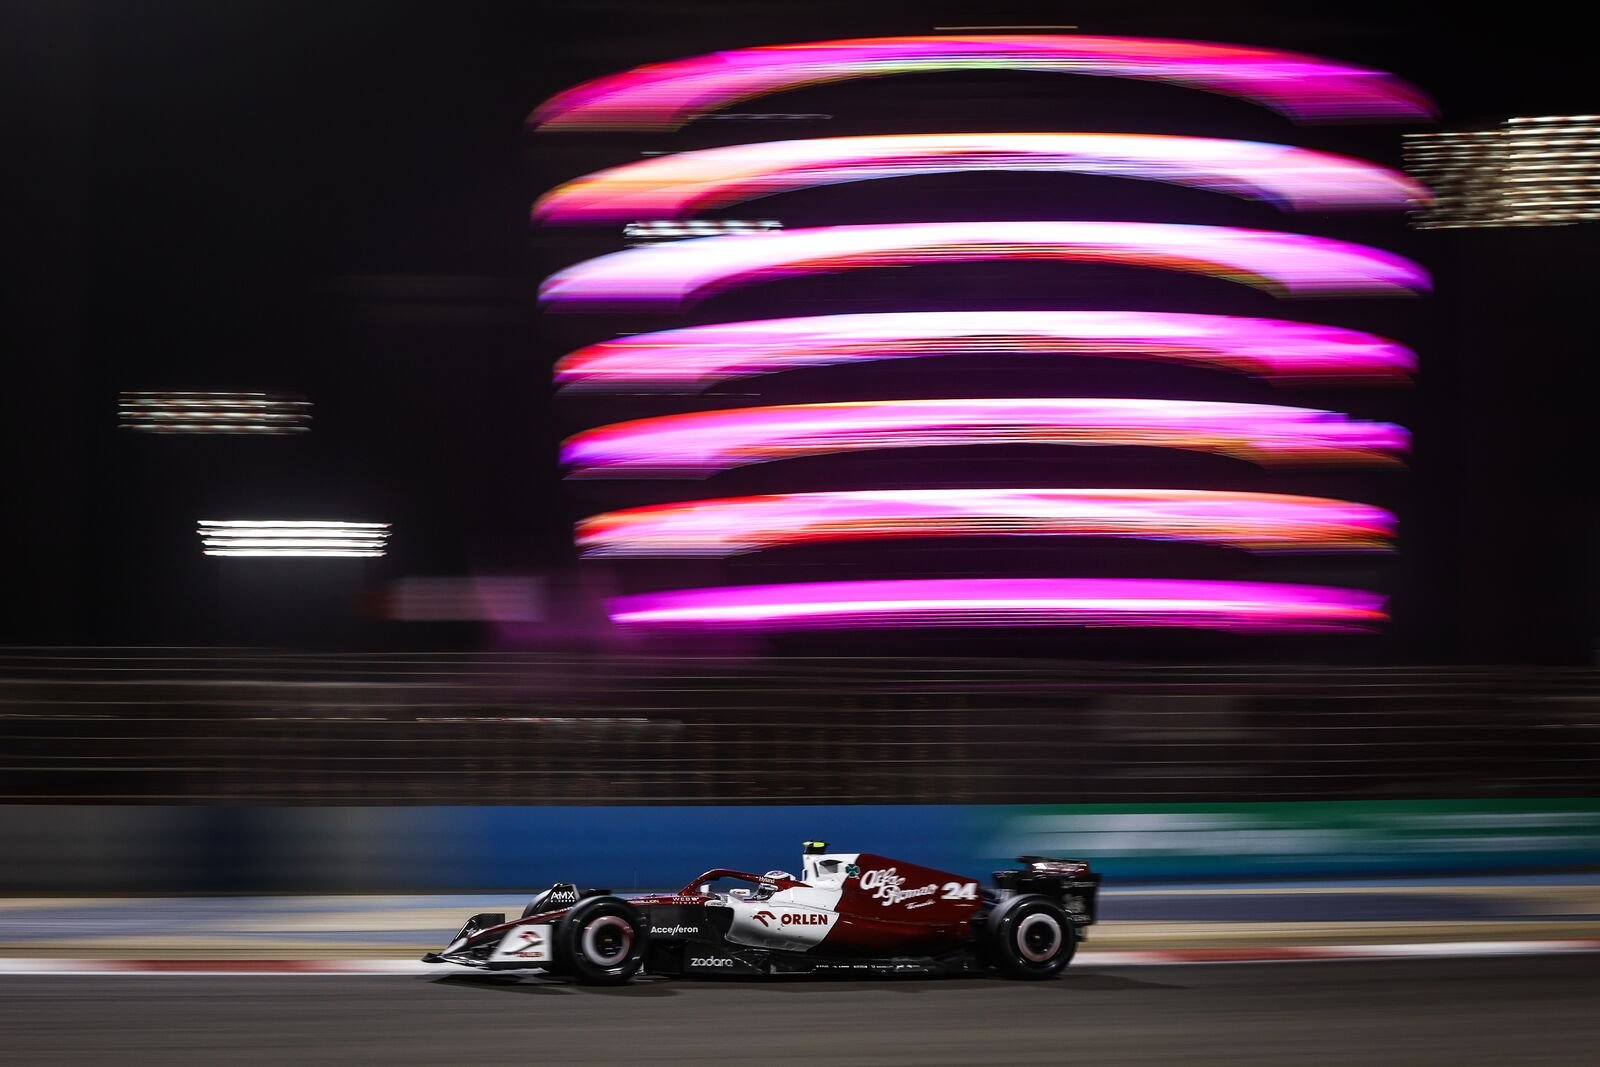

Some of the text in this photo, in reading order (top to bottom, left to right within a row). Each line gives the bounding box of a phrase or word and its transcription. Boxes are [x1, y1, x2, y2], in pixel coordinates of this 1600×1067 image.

[550, 891, 575, 900] AMX
[941, 882, 979, 900] 24
[781, 913, 828, 925] ORLEN
